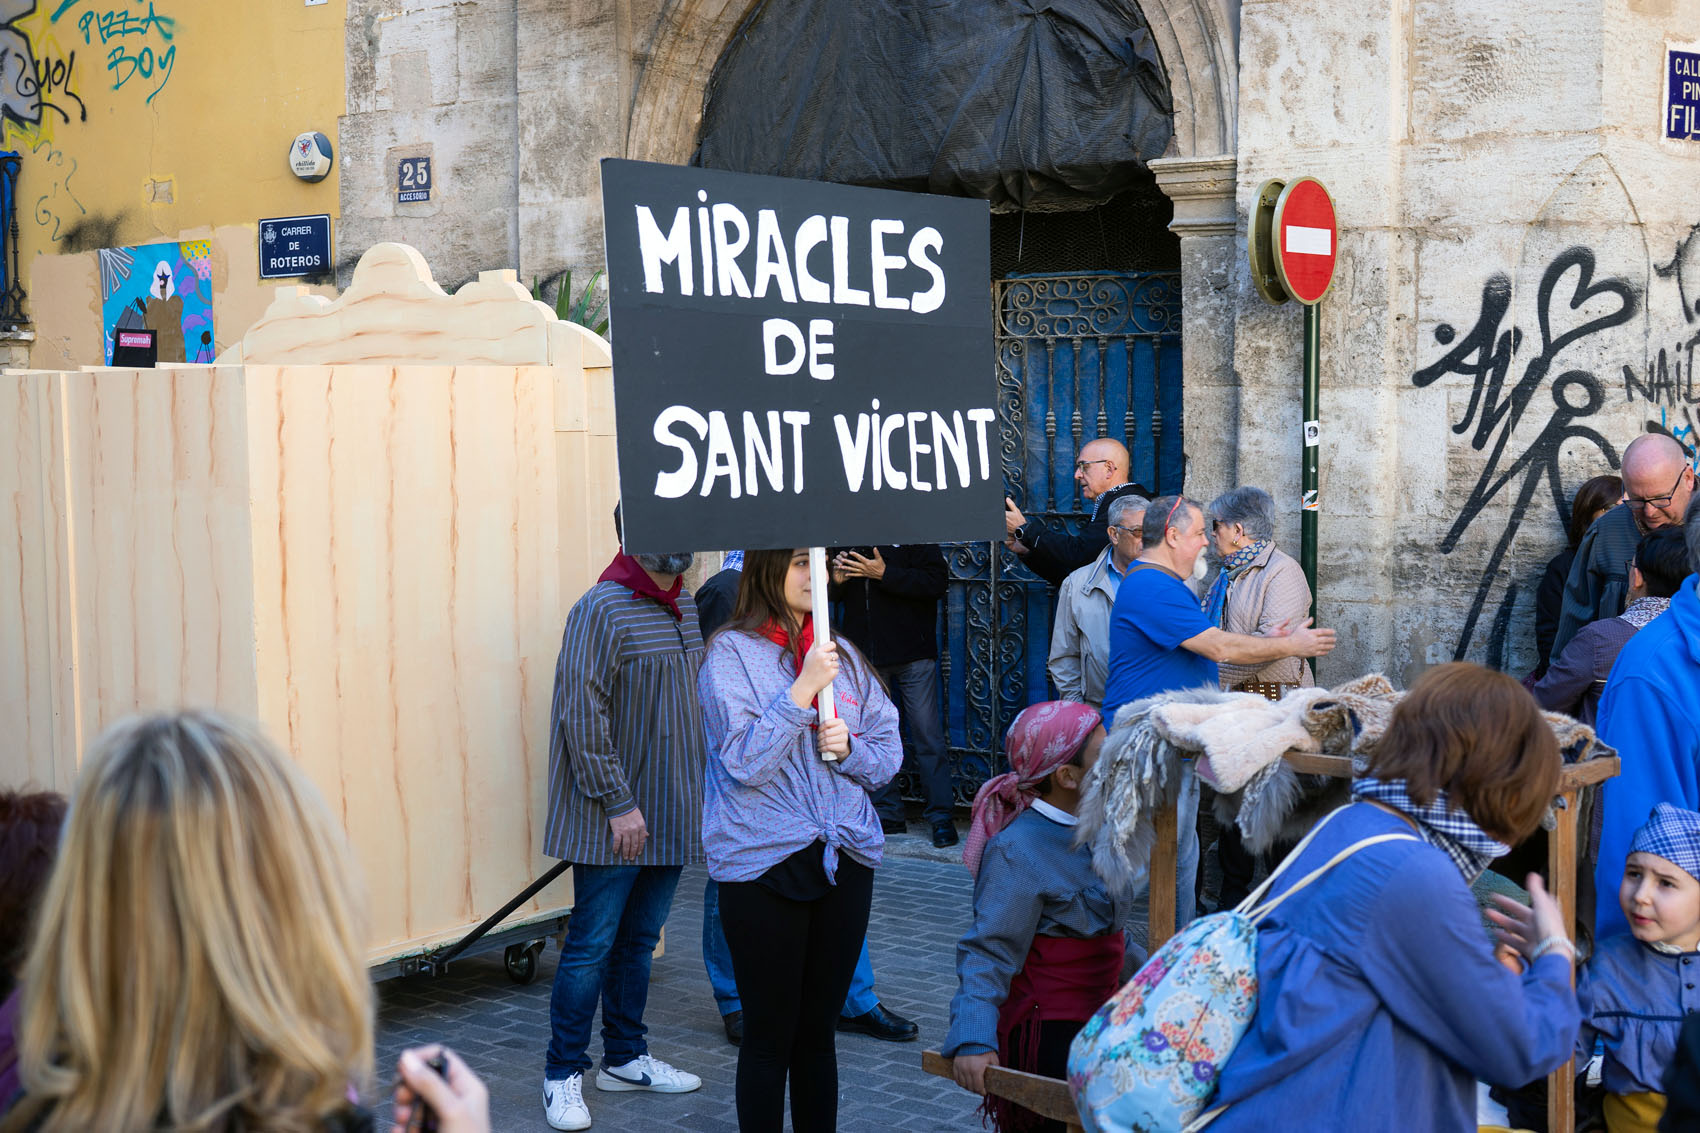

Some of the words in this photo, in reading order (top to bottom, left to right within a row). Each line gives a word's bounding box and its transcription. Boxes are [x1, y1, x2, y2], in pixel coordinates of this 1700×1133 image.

[78, 1, 175, 45] PIZZA
[107, 45, 177, 104] BOY
[402, 161, 428, 186] 25
[400, 192, 428, 201] ACCESORIO
[281, 225, 312, 237] CARRER
[288, 241, 300, 251] DE
[270, 255, 321, 269] ROTEROS
[763, 318, 835, 380] DE
[653, 405, 810, 499] SANT
